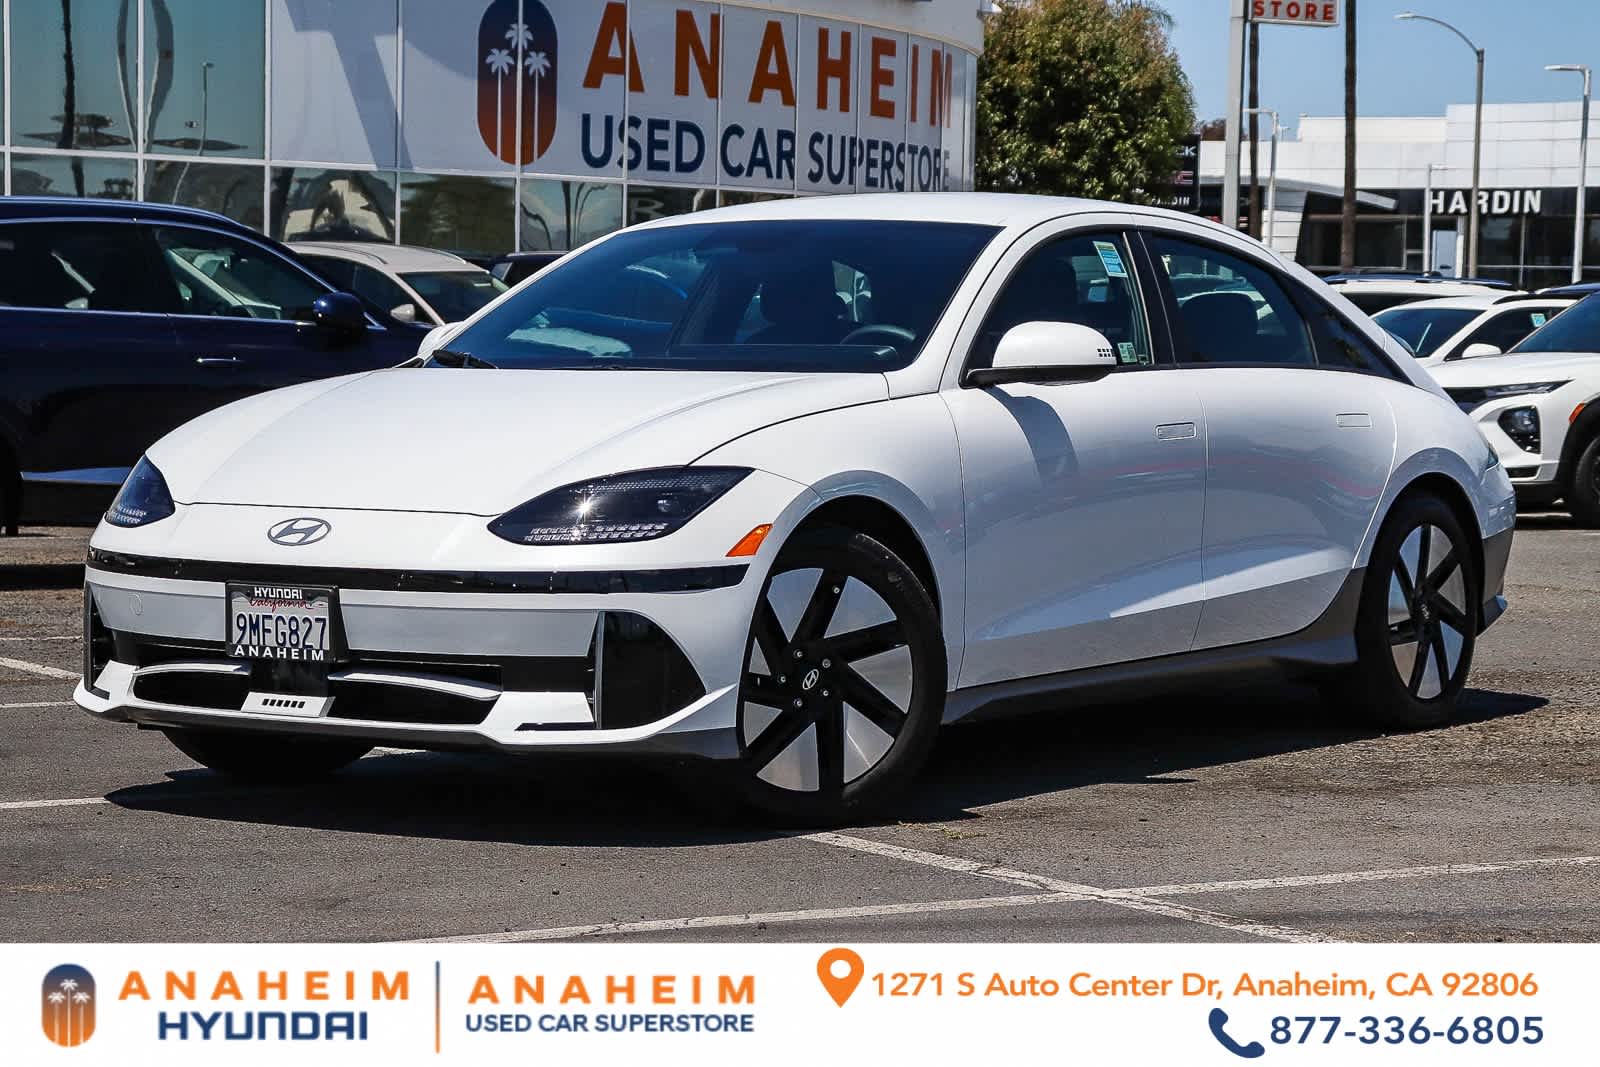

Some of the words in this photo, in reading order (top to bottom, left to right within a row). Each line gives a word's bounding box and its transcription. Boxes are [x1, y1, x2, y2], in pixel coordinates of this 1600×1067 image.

[1253, 0, 1335, 21] STORE
[582, 1, 953, 129] ANAHEIM
[581, 113, 706, 174] USED
[719, 123, 796, 181] CAR
[807, 131, 951, 193] SUPERSTORE
[1429, 189, 1543, 214] HARDIN
[254, 586, 303, 600] HYUNDAI
[235, 612, 328, 651] 9MFG827
[234, 644, 324, 661] ANAHEIM
